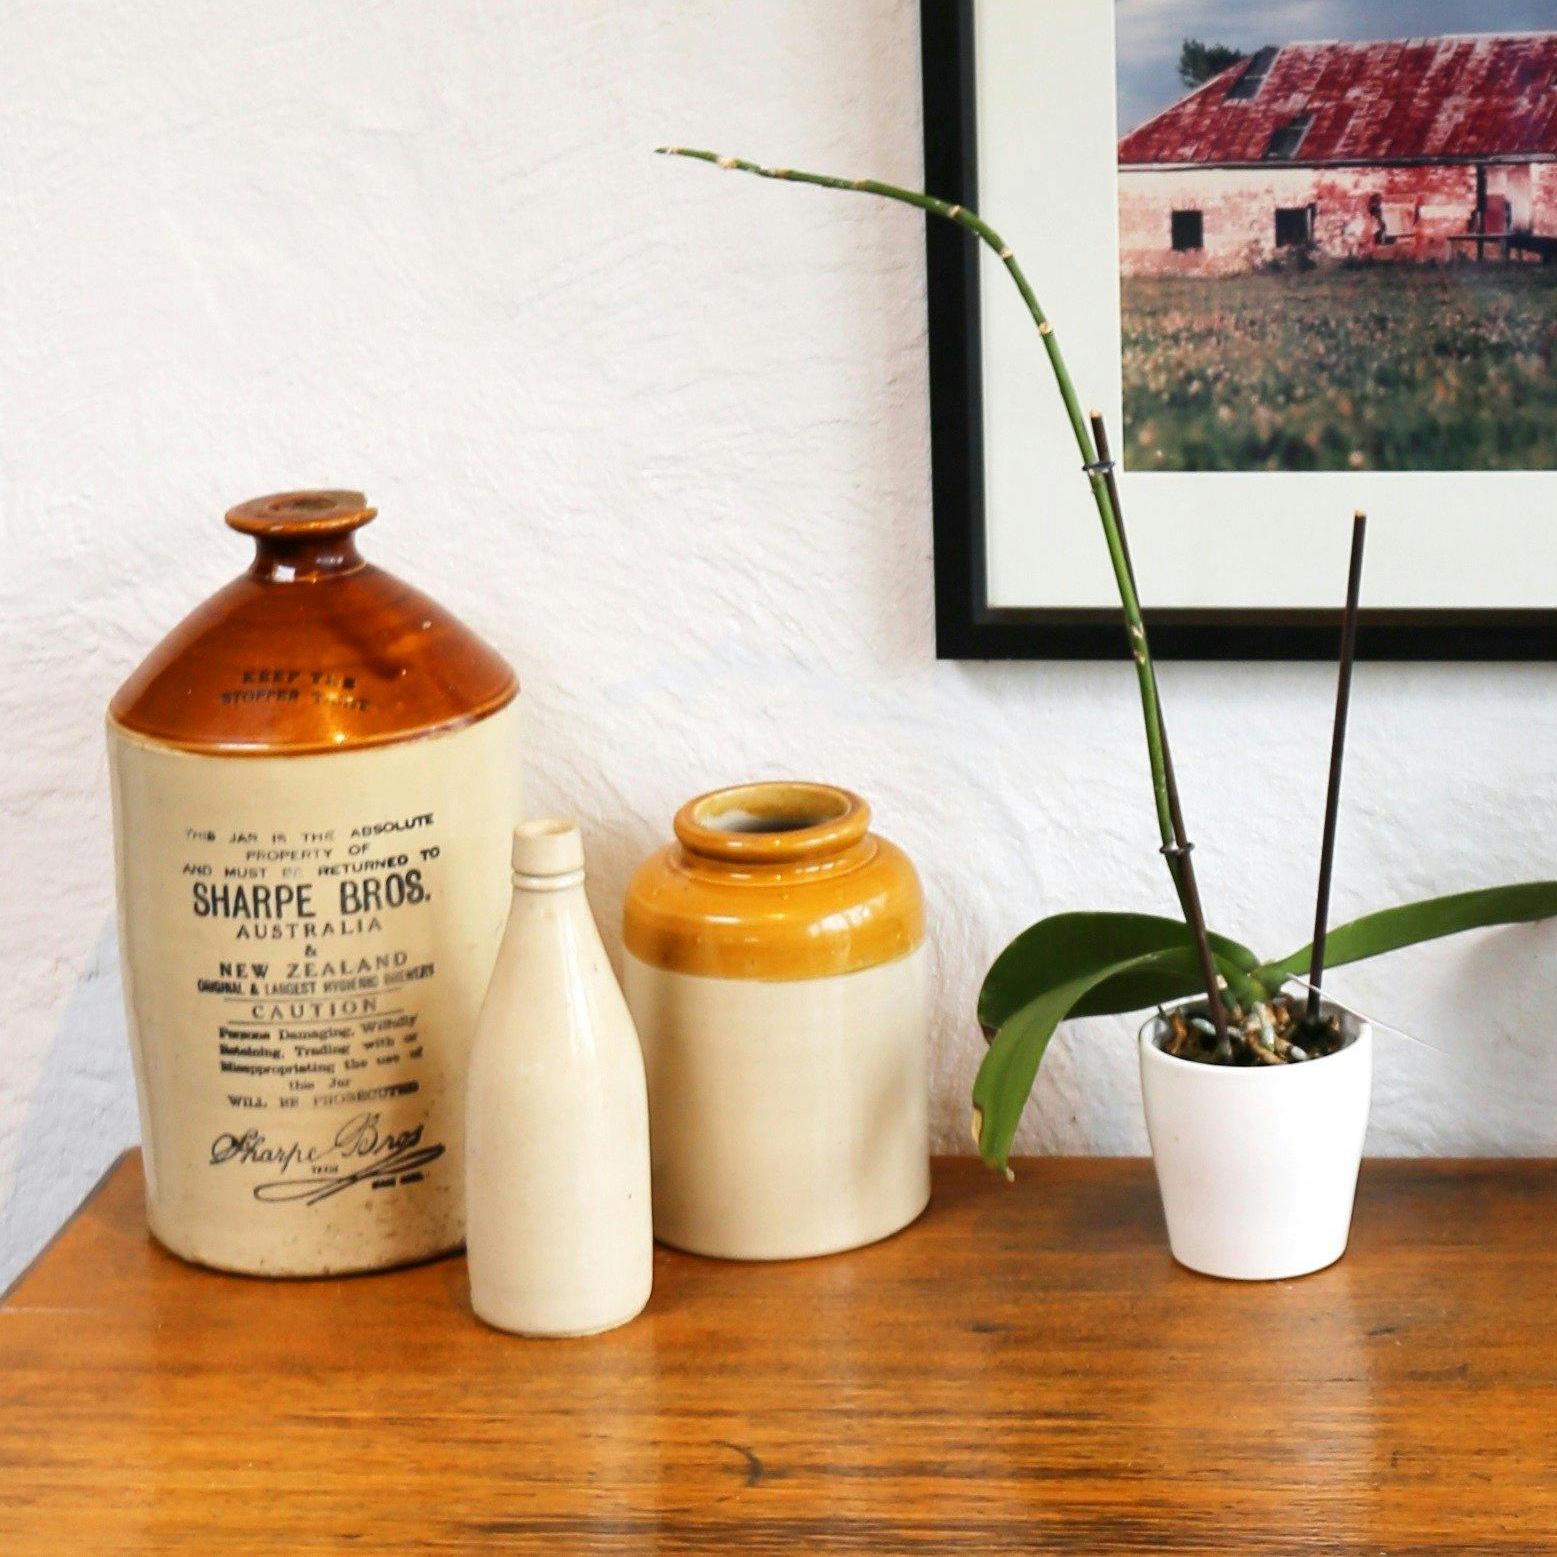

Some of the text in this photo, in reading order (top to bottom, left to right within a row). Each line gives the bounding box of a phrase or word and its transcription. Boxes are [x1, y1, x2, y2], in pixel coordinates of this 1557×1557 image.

[229, 832, 258, 844] JAR
[272, 832, 287, 843] IS
[303, 830, 335, 842] THE
[350, 812, 435, 839] ABSOLUTE
[183, 863, 212, 876] AND
[224, 867, 267, 879] MUST
[317, 854, 409, 877] RETURNED
[419, 845, 441, 862] TO
[246, 843, 371, 862] PROPERTY OF
[193, 868, 432, 919] SHARPE BROS.
[236, 917, 383, 941] AUSTRALIA
[219, 950, 408, 979] NEW ZEALAND
[304, 943, 318, 957] &
[252, 997, 378, 1020] CAUTION
[209, 1112, 425, 1174] Sharpe Bros
